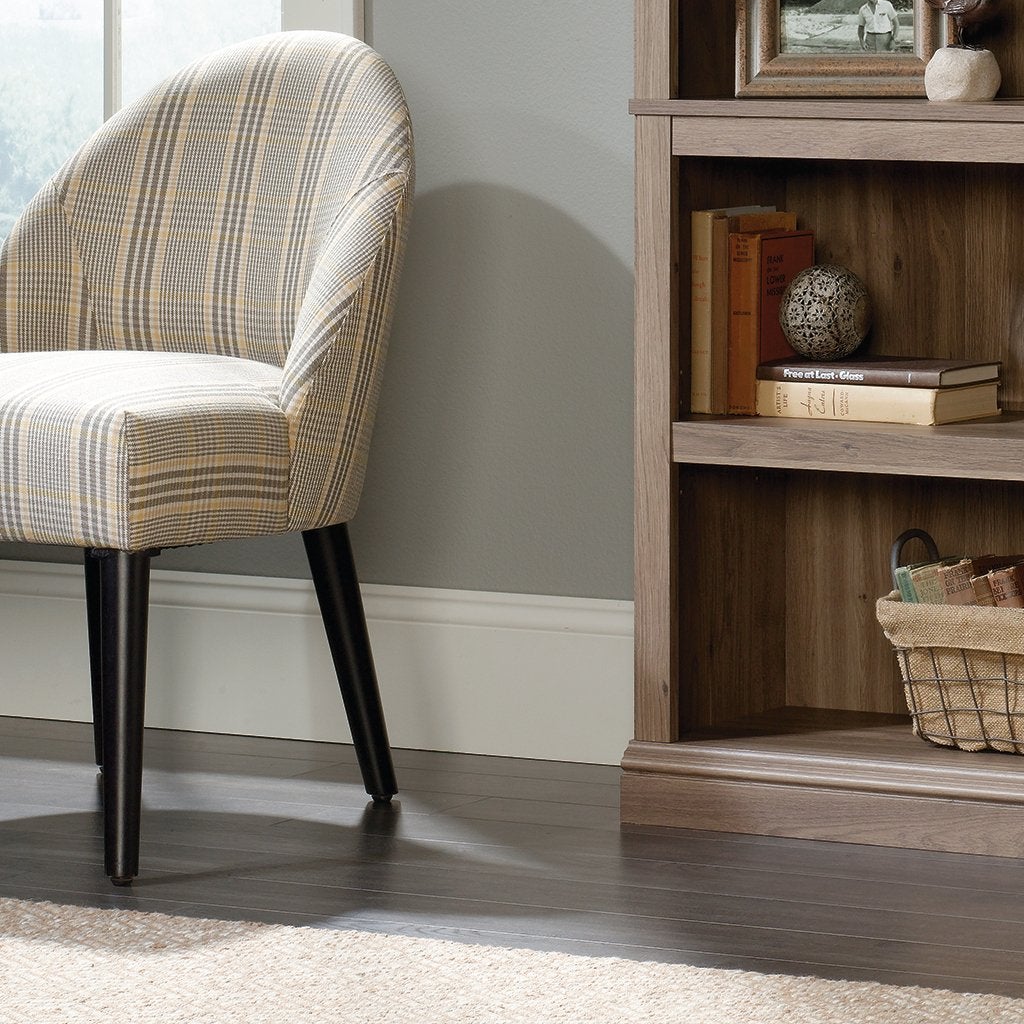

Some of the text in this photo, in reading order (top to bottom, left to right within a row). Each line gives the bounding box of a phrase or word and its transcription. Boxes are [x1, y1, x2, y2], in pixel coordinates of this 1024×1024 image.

[784, 368, 864, 381] Free at Last Glass
[944, 567, 968, 579] FRANK
[946, 582, 972, 594] PRAIRI
